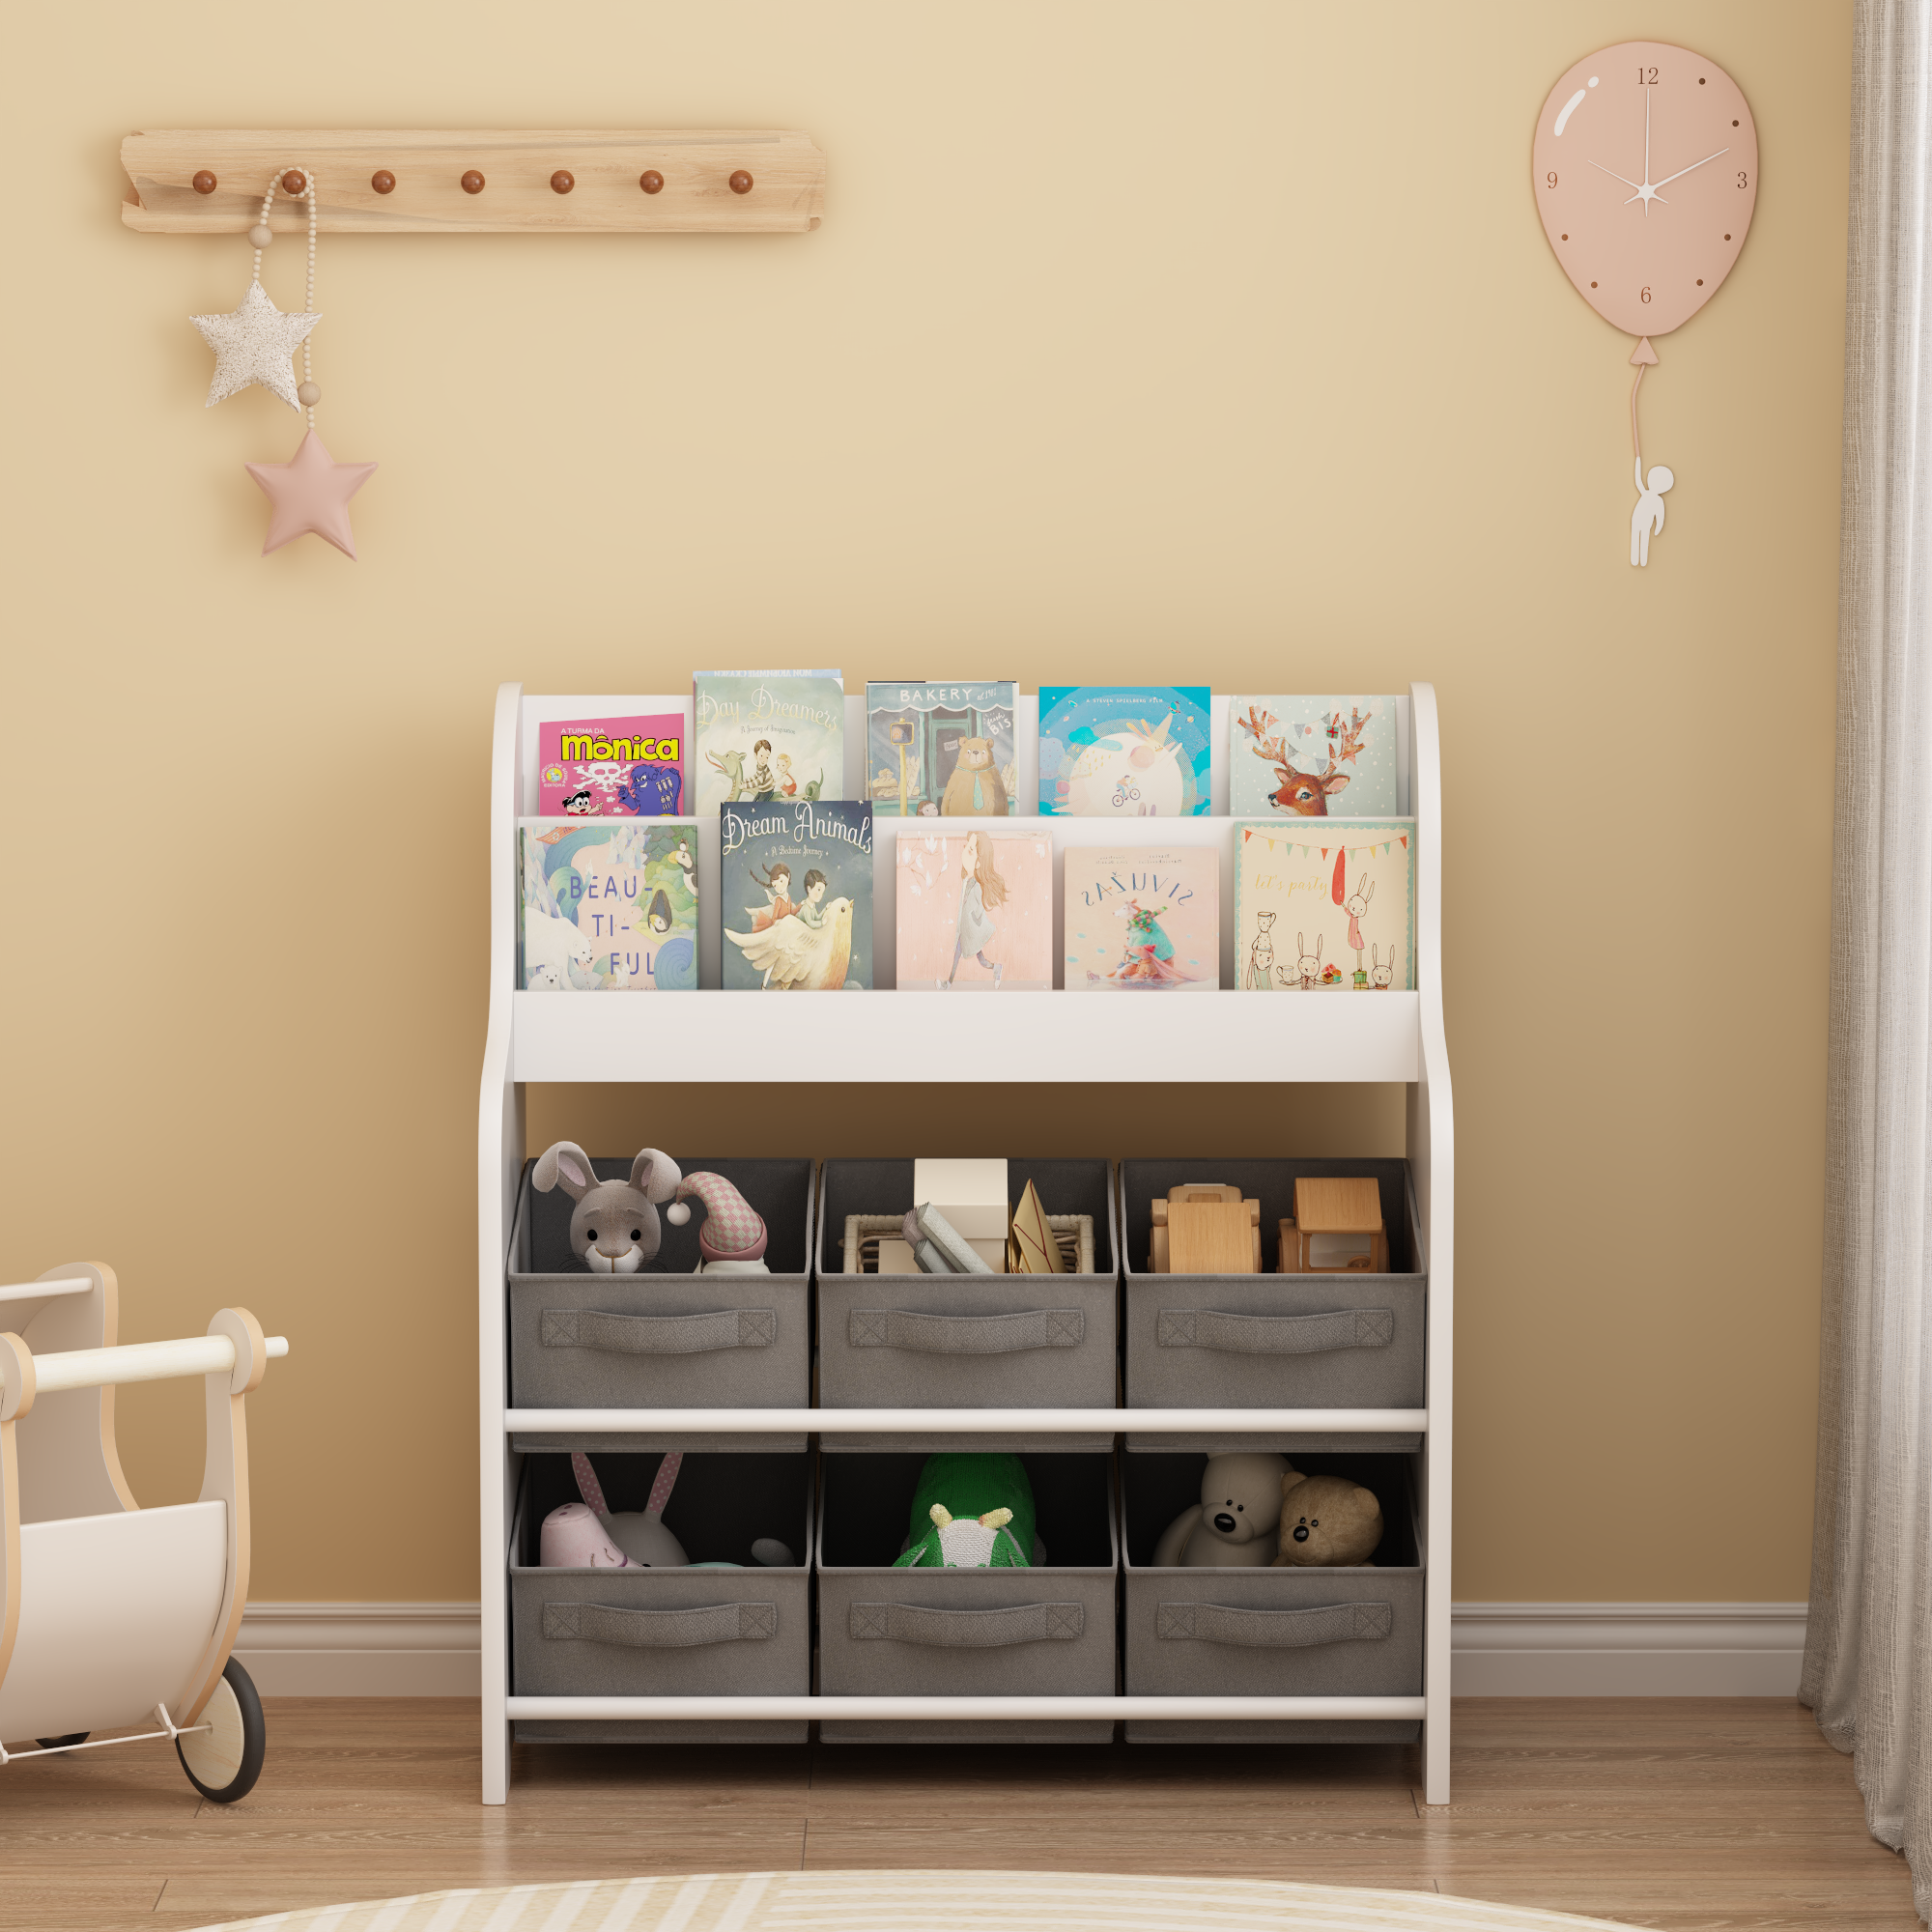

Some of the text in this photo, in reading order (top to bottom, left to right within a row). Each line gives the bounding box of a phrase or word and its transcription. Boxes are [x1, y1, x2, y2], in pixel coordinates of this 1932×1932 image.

[1637, 67, 1659, 85] 12
[1547, 171, 1558, 189] 9
[1737, 171, 1747, 189] 3
[1640, 286, 1652, 304] 6
[899, 687, 973, 702] BAKERY
[696, 683, 838, 731] Day Dreamers
[722, 802, 872, 856] Dream Animals
[803, 844, 824, 859] Journey
[1255, 873, 1329, 900] let's party
